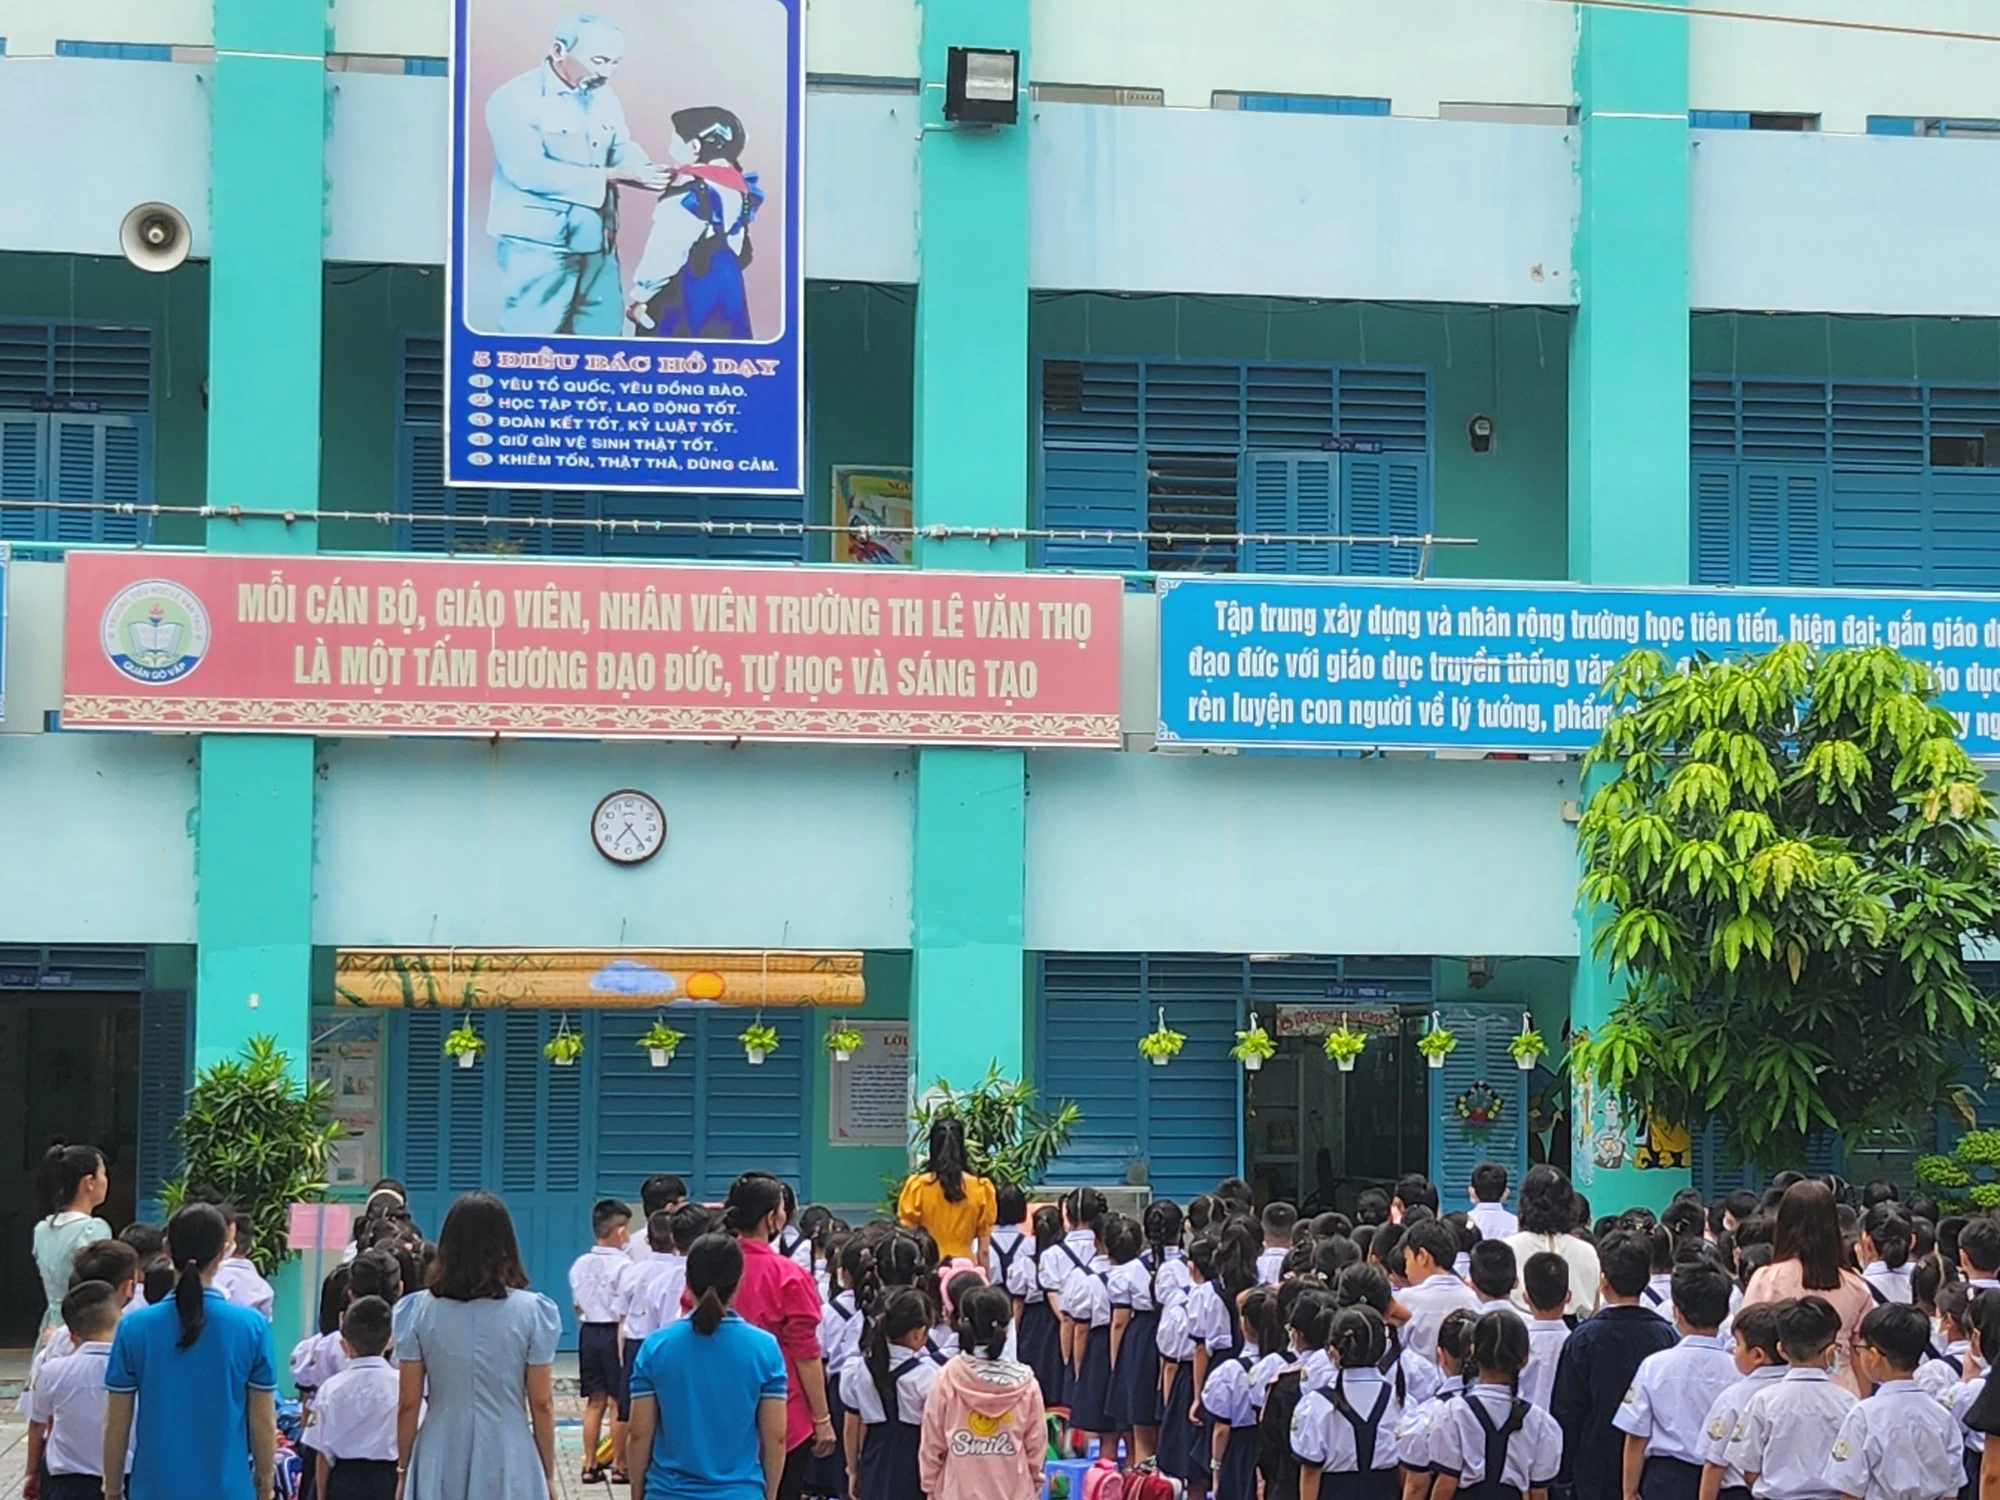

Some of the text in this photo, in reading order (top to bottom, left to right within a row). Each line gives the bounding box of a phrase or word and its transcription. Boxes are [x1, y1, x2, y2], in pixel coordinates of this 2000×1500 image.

[472, 350, 491, 368] 5
[585, 351, 651, 373] BÁC
[712, 357, 780, 378] DẠY
[499, 376, 533, 391] YÊU
[620, 380, 652, 395] YÊU
[708, 382, 748, 397] BÀO.
[499, 397, 535, 411] HỌC
[616, 402, 649, 413] LAO
[653, 400, 701, 415] ĐỘNG
[499, 415, 545, 428] ĐOÀN
[592, 437, 630, 450] SINH
[499, 453, 551, 466] KHIÊM
[598, 455, 641, 470] THẬT
[238, 570, 1092, 649] MỖI CÁN BỘ, GIÁO VIÊN, NHÂN VIÊN TRƯỜNG TH LÊ VĂN THỌ
[1214, 600, 1255, 638] Tập
[1260, 602, 1317, 637] trung
[1323, 602, 1362, 638] xây
[1368, 604, 1421, 642] dựng
[1426, 604, 1452, 637] và
[1457, 606, 1511, 638] nhân
[1517, 606, 1565, 645] rộng
[1571, 608, 1639, 644] trường
[1645, 610, 1685, 648] học
[1690, 612, 1732, 643] tiên
[1789, 612, 1836, 651] hiện
[1887, 609, 1927, 650] gắn
[1932, 616, 1978, 650] giáo
[294, 634, 1038, 707] LÀ MỘT TẤM GƯƠNG ĐẠO ĐỨC, TỰ HỌC VÀ SÁNG TẠO
[1189, 645, 1230, 683] đạo
[1237, 645, 1279, 678] đức
[1285, 646, 1320, 679] với
[1326, 647, 1375, 683] giáo
[1430, 646, 1501, 686] truyền
[1507, 648, 1570, 688] thống
[1188, 689, 1226, 723] rèn
[1232, 692, 1295, 730] luyện
[1301, 699, 1343, 725] con
[1349, 694, 1412, 729] người
[1418, 691, 1445, 727] về
[1451, 695, 1472, 732] lý
[1477, 694, 1547, 733] tưởng,
[951, 1429, 1016, 1456] Smile
